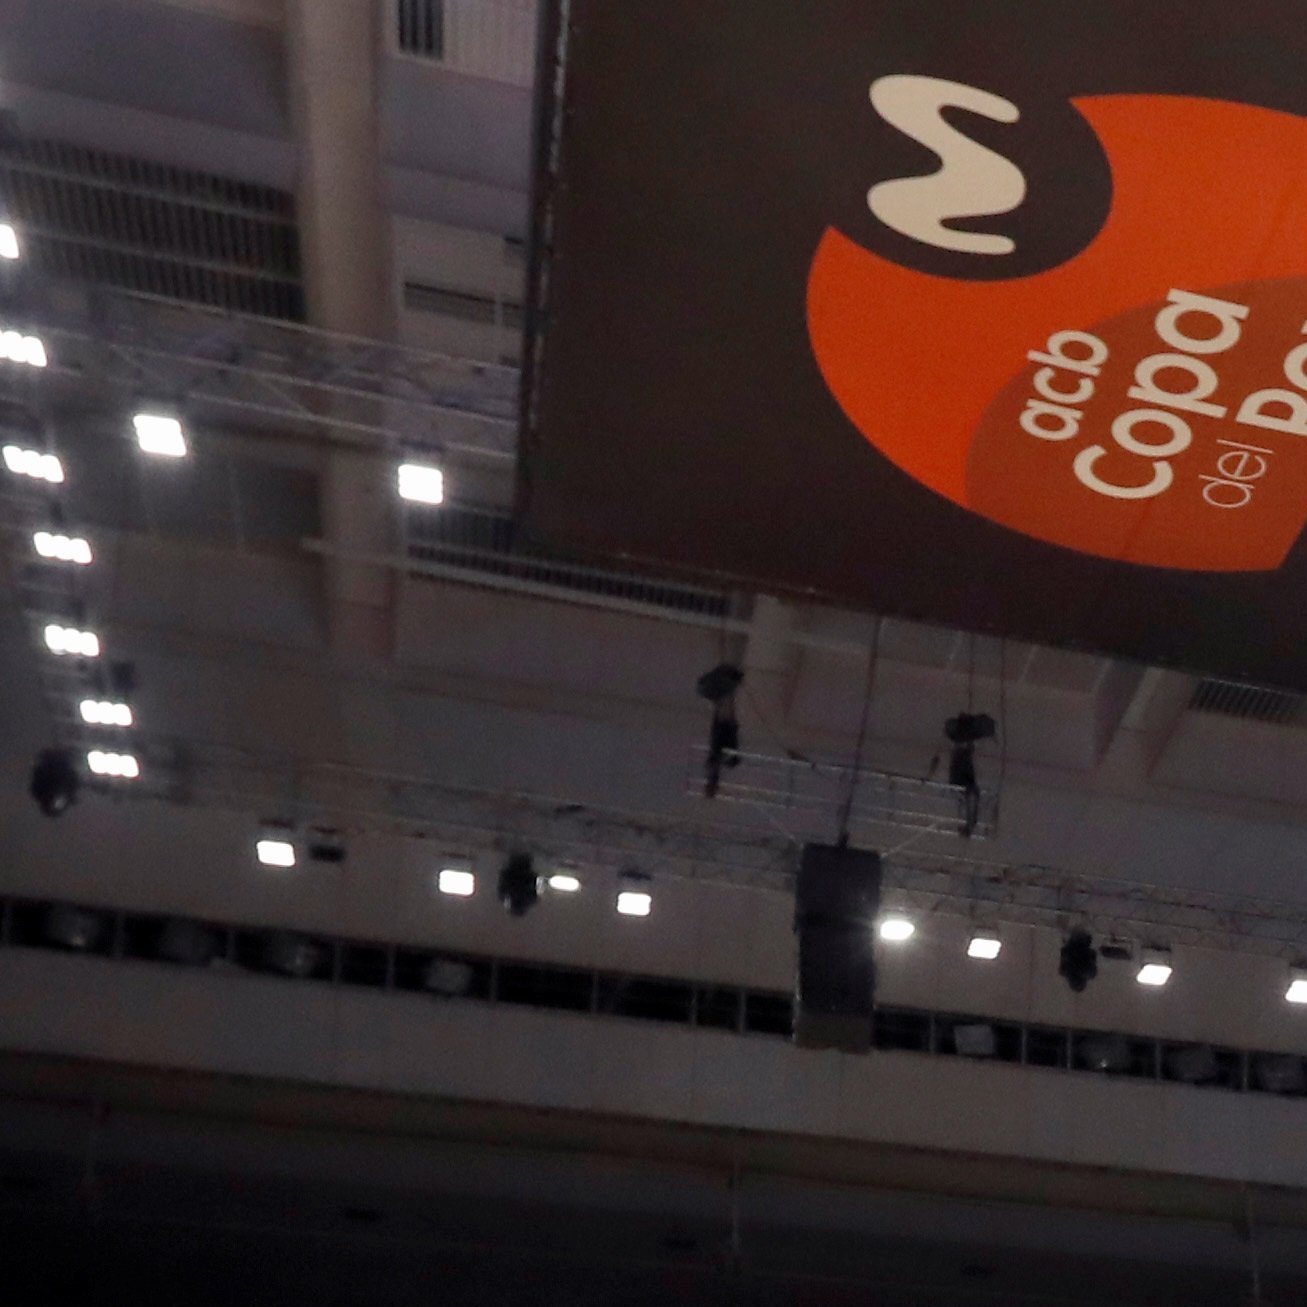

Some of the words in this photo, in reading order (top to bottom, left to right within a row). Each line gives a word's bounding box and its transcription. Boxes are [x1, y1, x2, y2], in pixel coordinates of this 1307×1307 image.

[1019, 330, 1109, 441] acb
[1073, 288, 1250, 499] Copa
[1198, 439, 1275, 508] del
